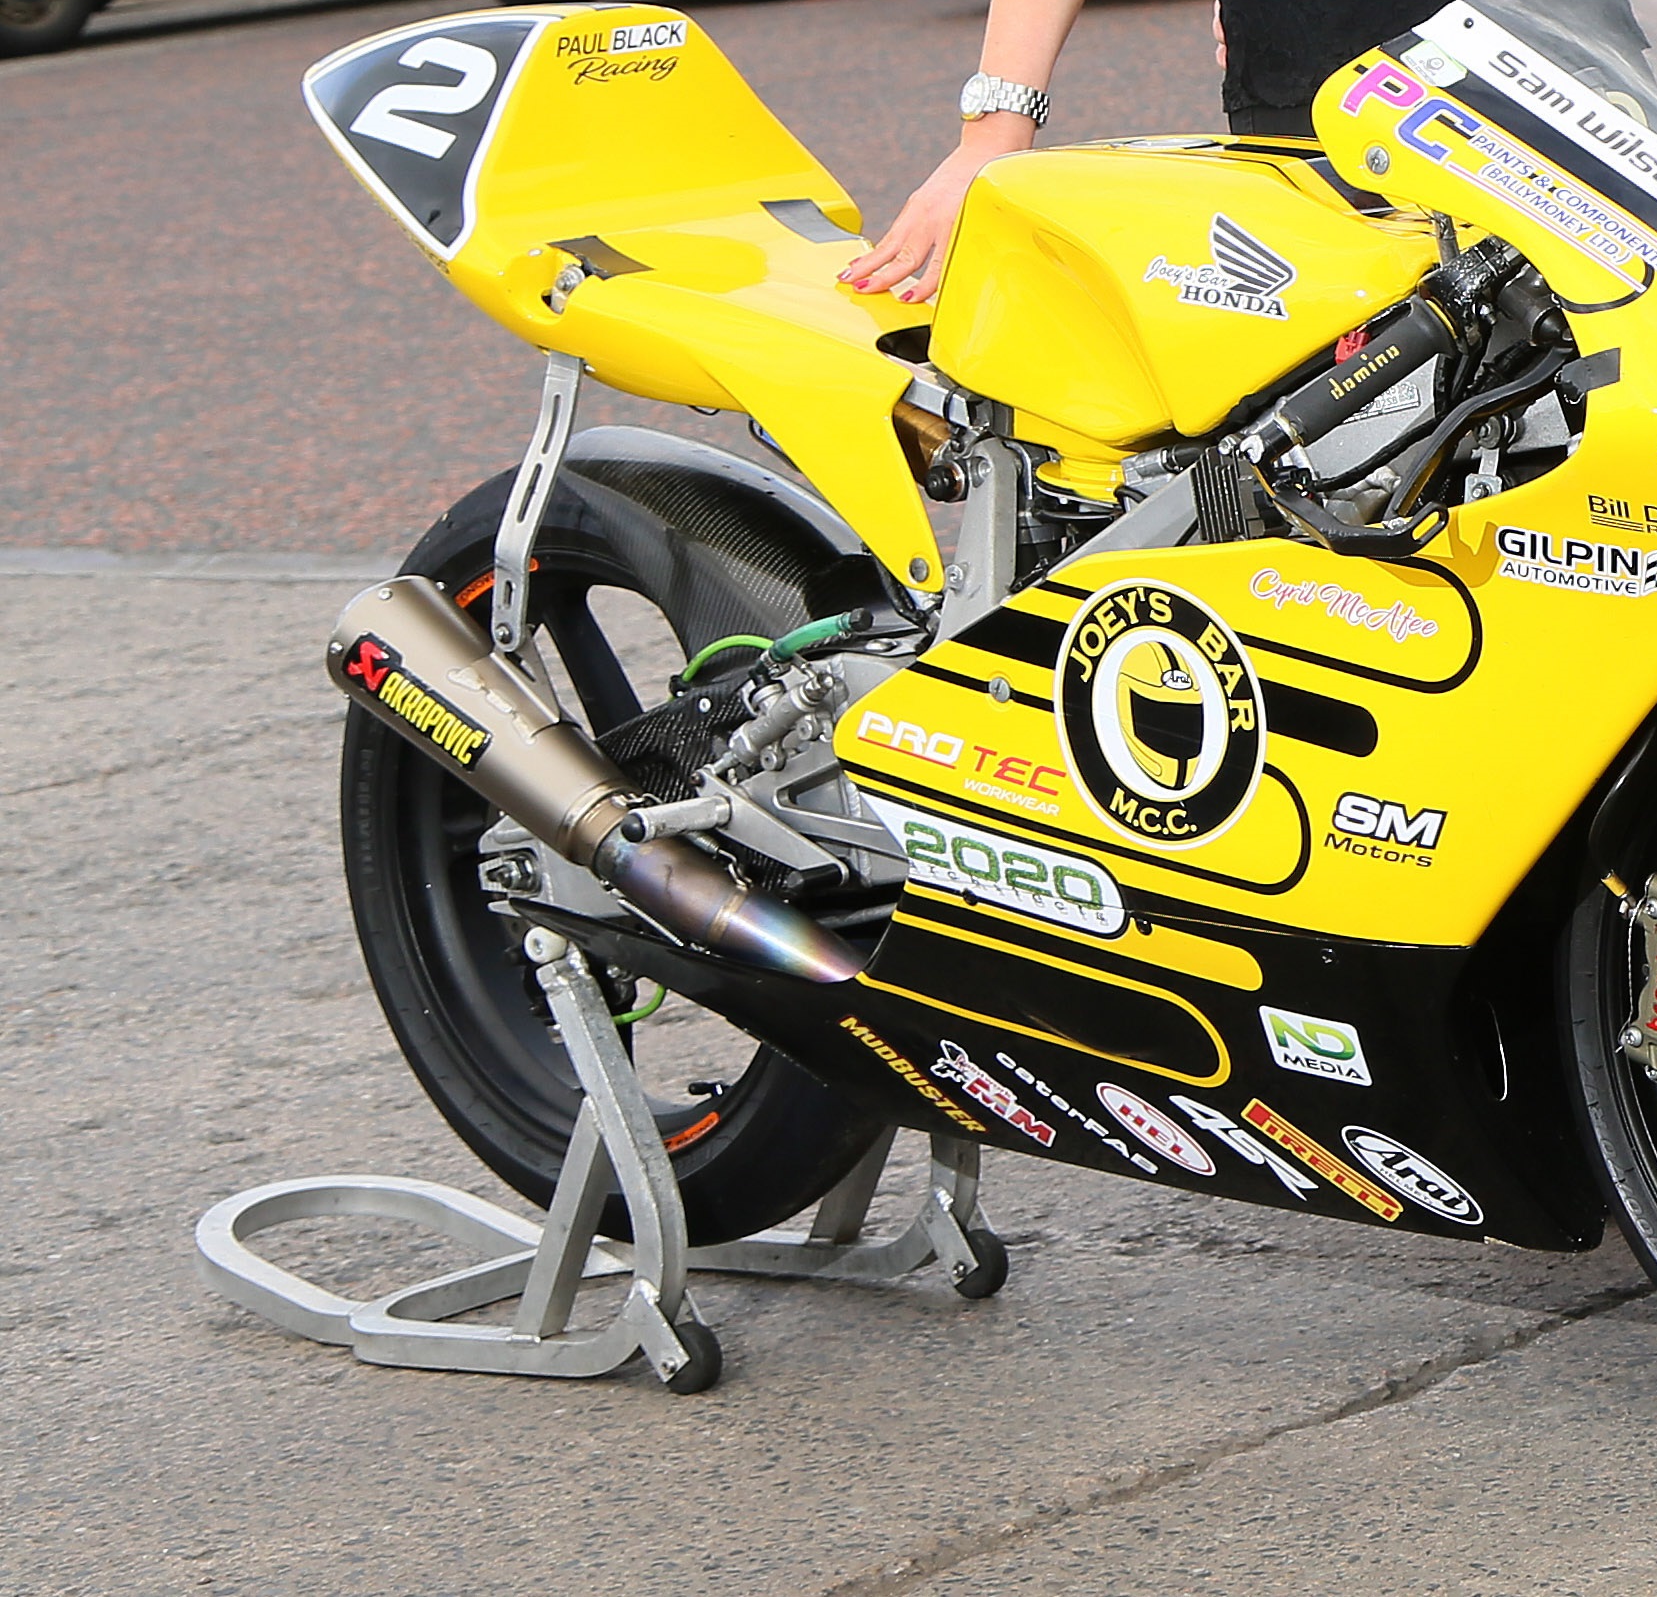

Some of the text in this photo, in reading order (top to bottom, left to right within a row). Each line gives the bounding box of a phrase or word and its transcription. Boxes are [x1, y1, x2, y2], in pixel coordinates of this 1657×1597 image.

[556, 21, 684, 58] PAUL BLACK
[349, 36, 498, 161] 2
[566, 54, 680, 86] Racing
[1488, 49, 1575, 116] Sam
[1339, 60, 1479, 167] PC
[1472, 131, 1532, 180] PAINTS
[1534, 172, 1553, 192] &
[1145, 256, 1230, 288] Joey's Bar
[1181, 284, 1287, 318] HONDA
[1329, 344, 1401, 401] domino
[1587, 494, 1630, 519] Bill
[1498, 527, 1639, 577] GILPIN
[1501, 560, 1638, 595] AUTOMOTIVE
[1250, 567, 1439, 644] Cyril McAfee
[1068, 587, 1256, 734] JOEY'S BAR
[858, 710, 1067, 797] PRO TEC
[963, 777, 1061, 817] WORKWEAR
[1109, 786, 1198, 836] M.C.C.
[1333, 794, 1445, 847] SM
[903, 820, 1104, 911] 2020
[1323, 833, 1432, 868] Motors
[839, 1015, 987, 1135] MUDBUSTER
[1281, 1052, 1362, 1080] MEDIA
[1118, 1104, 1191, 1165] HEL
[1245, 1100, 1399, 1220] PIRELLI
[1350, 1133, 1470, 1212] Arai
